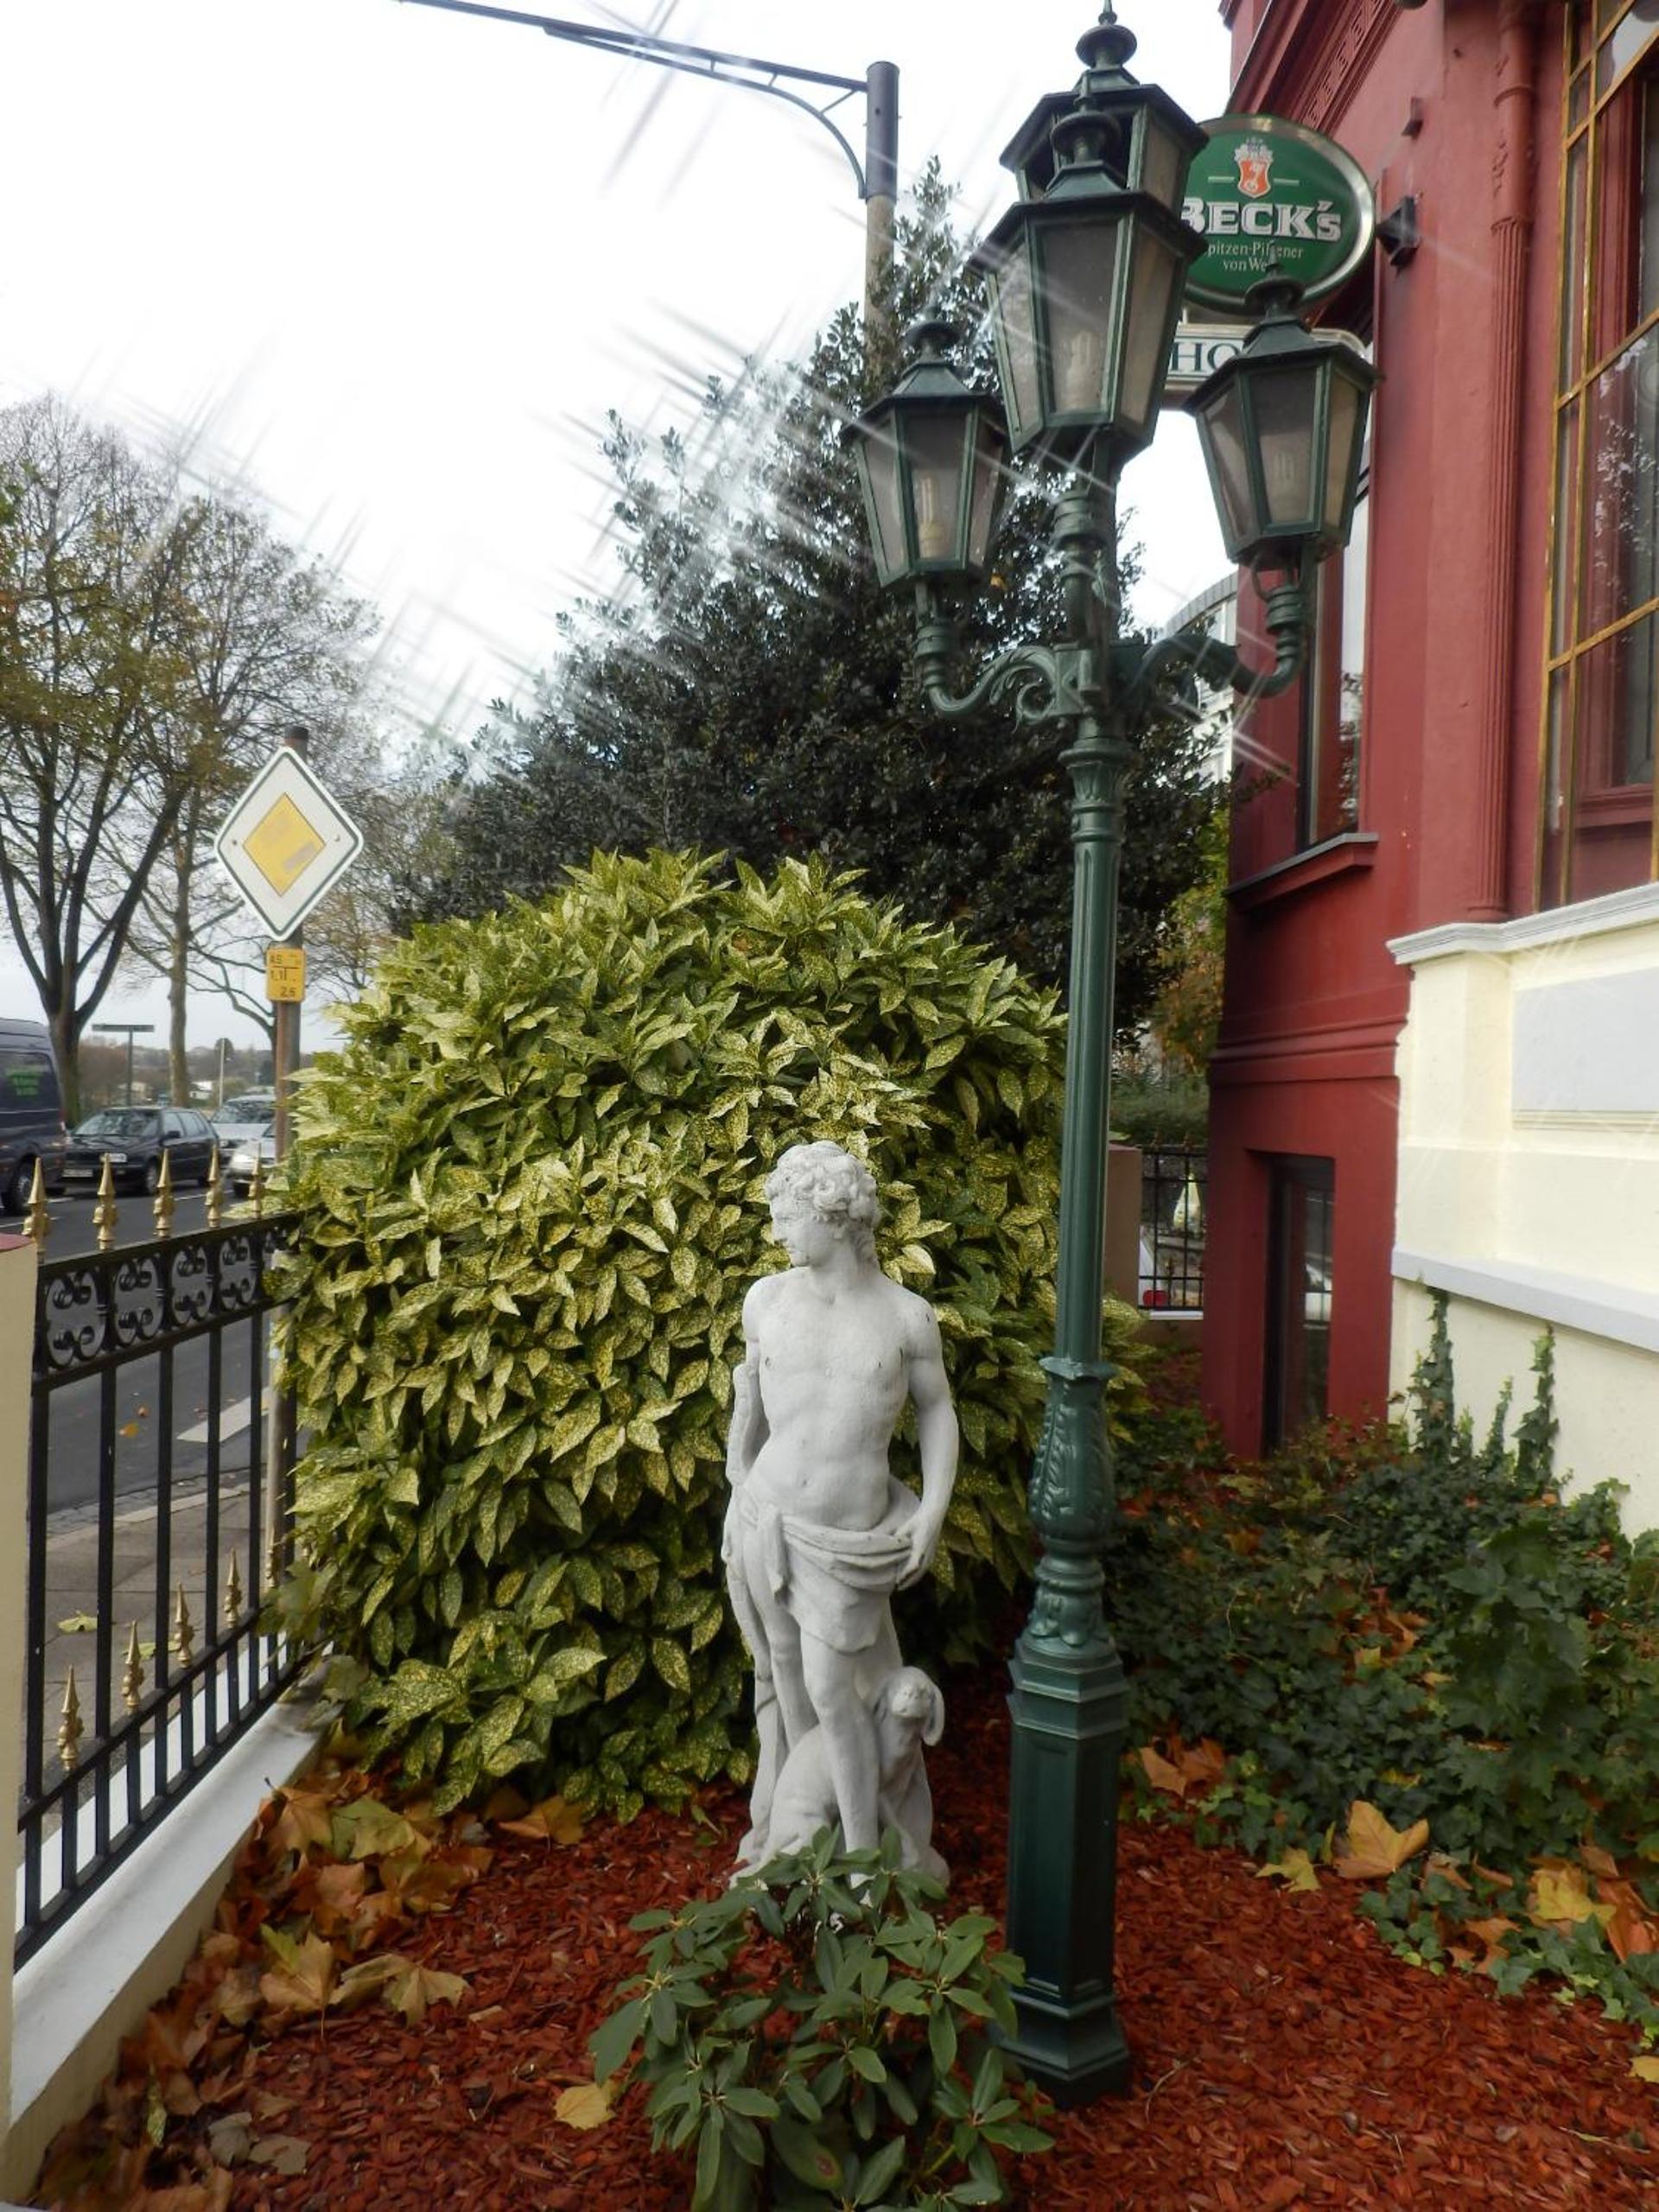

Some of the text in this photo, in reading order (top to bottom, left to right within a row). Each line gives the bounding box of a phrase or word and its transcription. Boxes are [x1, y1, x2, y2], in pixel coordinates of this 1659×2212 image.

[1208, 240, 1304, 258] pitzen-Pilener
[1223, 260, 1248, 271] von
[1170, 341, 1241, 372] HO
